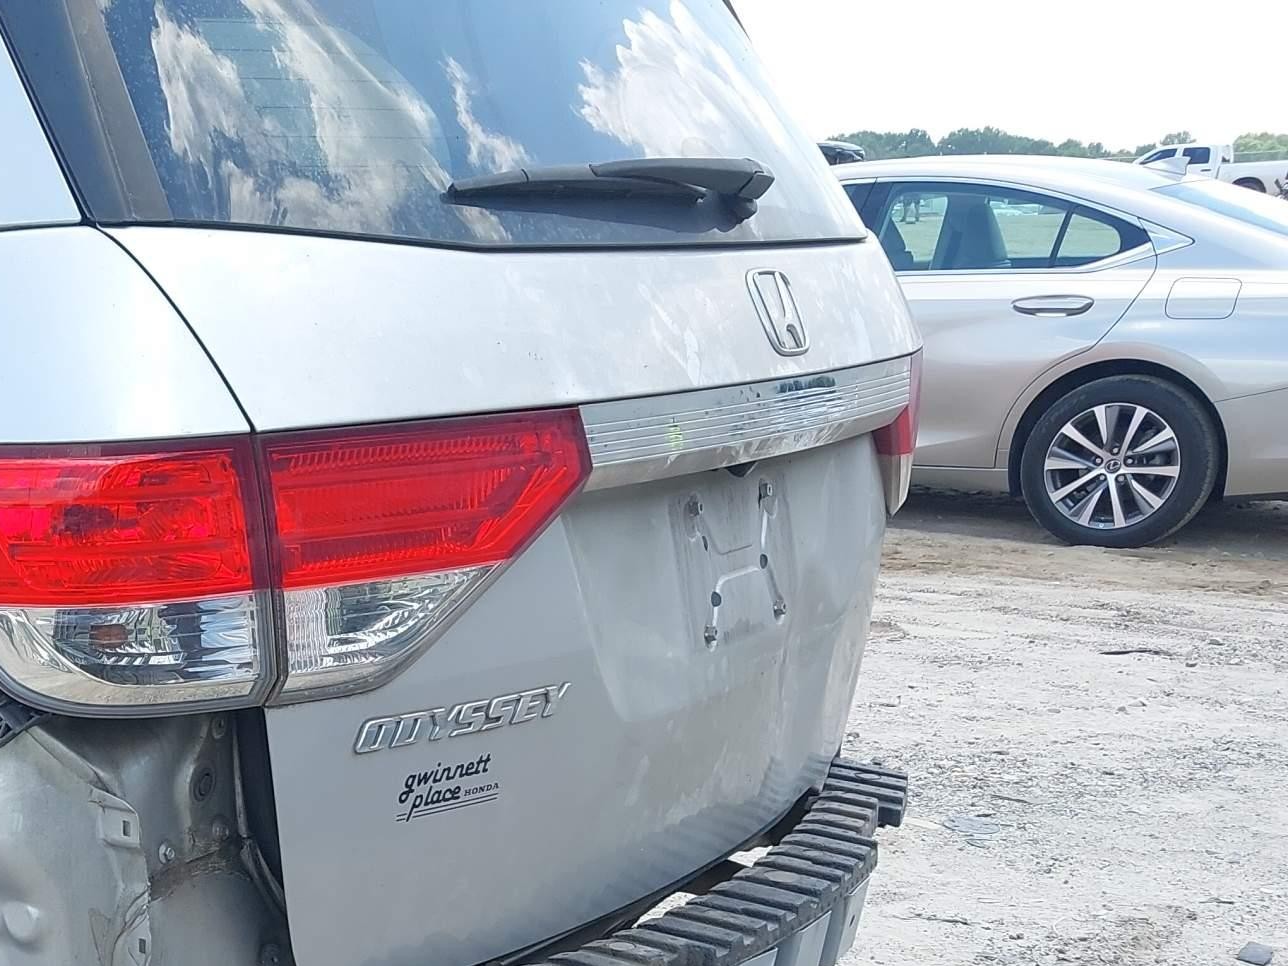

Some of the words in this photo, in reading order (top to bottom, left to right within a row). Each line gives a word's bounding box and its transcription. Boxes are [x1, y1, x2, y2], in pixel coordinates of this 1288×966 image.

[353, 682, 572, 754] ODYSSEY
[398, 753, 492, 804] gwinnett
[405, 784, 462, 822] place
[463, 782, 500, 797] HONDA
